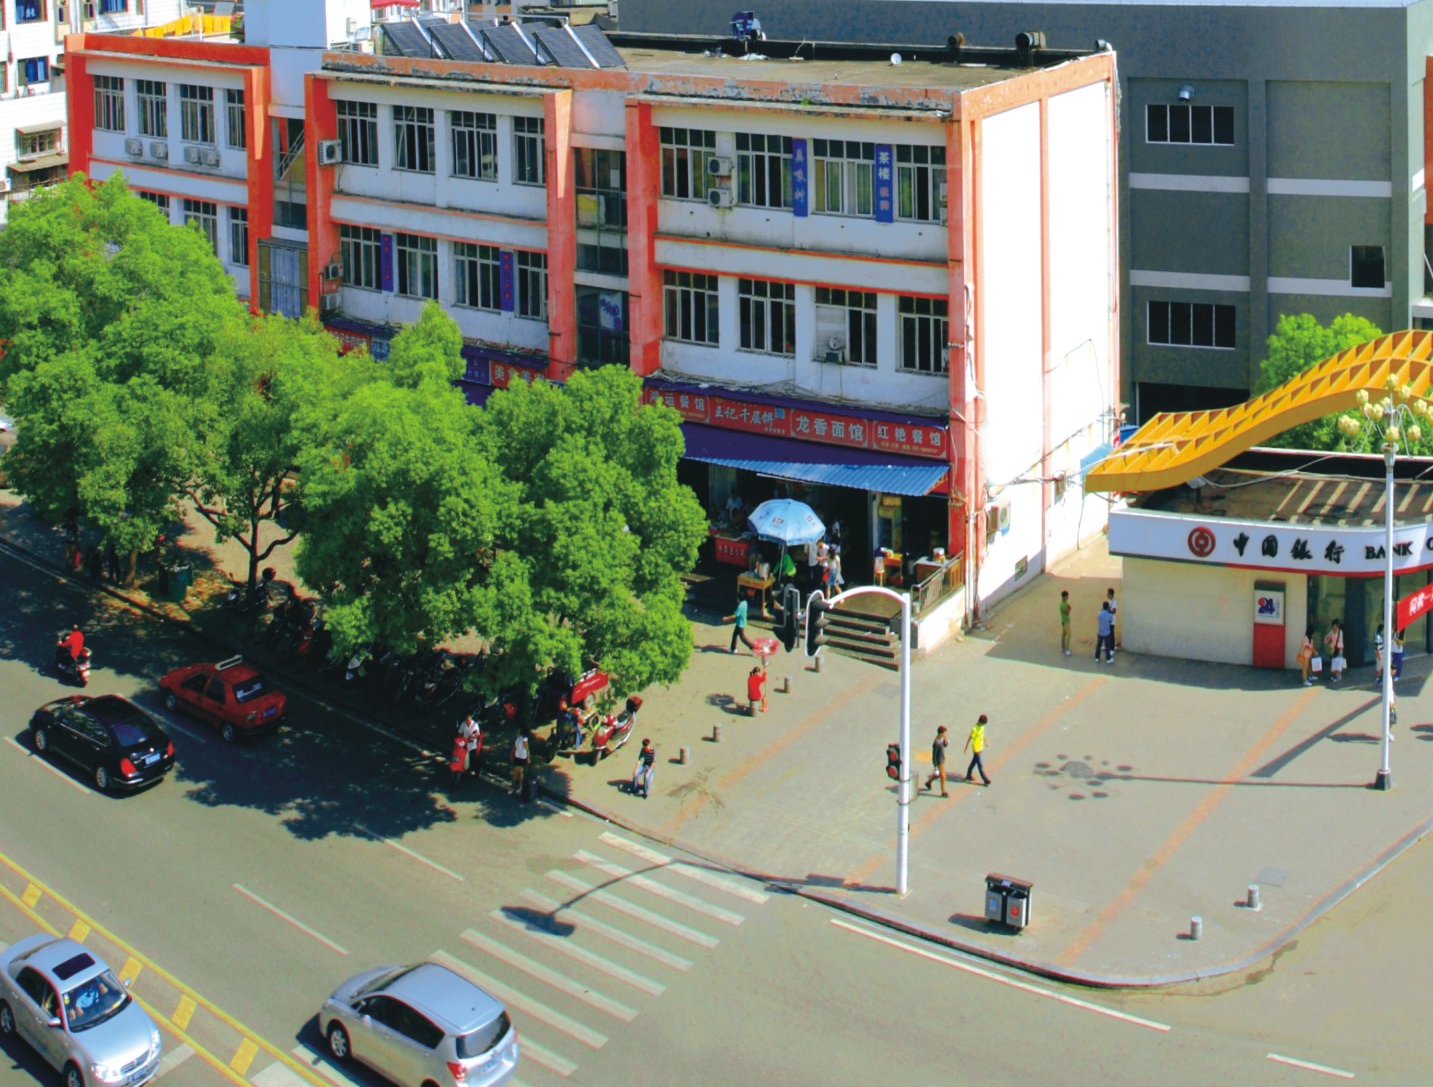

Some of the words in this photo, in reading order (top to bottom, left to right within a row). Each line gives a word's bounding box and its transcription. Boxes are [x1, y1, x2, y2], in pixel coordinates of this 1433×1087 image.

[796, 415, 864, 442] 龙香面馆
[1233, 531, 1345, 564] 中国银行
[1365, 540, 1413, 561] BANK
